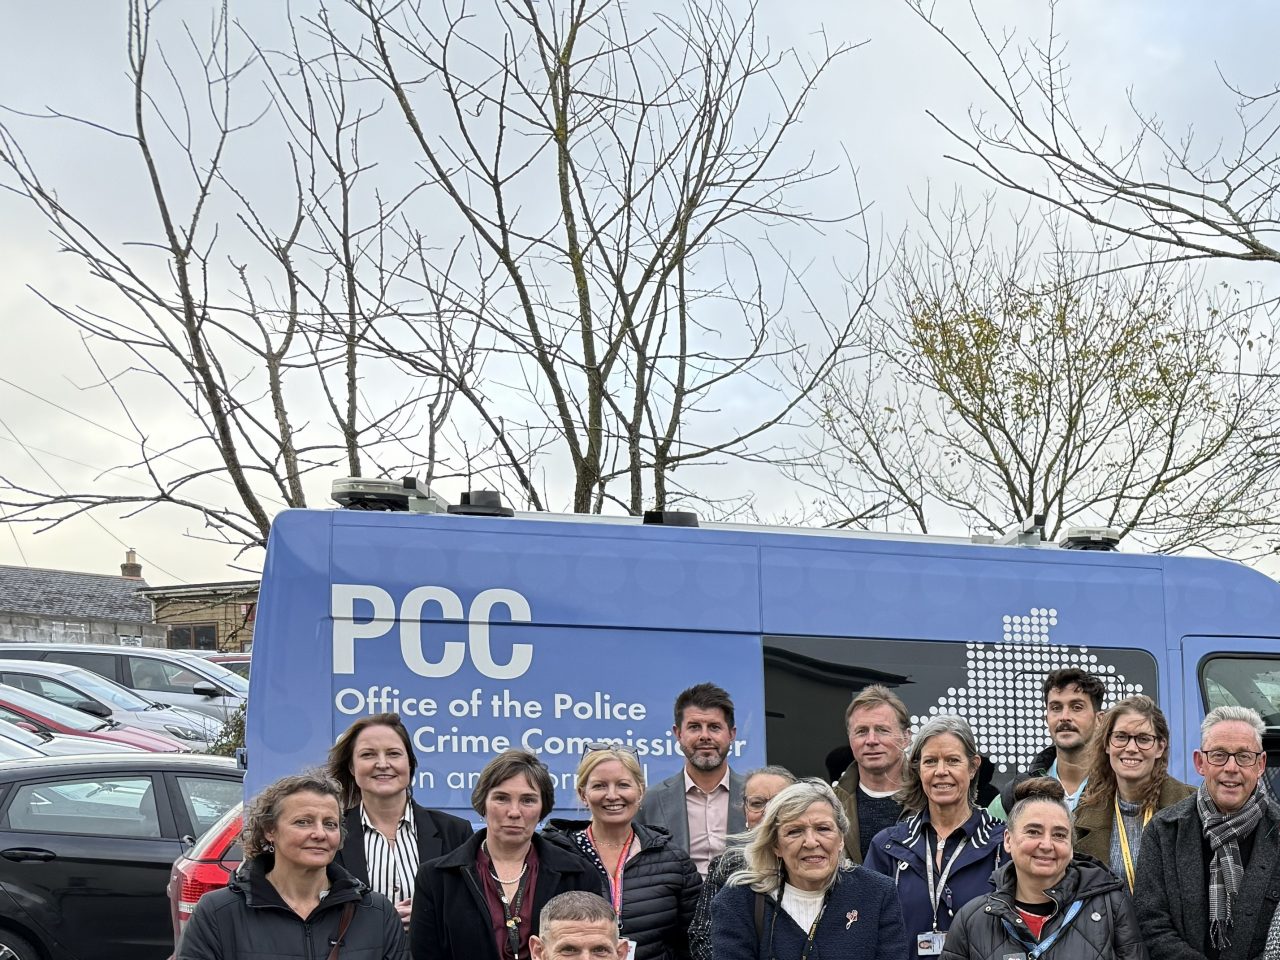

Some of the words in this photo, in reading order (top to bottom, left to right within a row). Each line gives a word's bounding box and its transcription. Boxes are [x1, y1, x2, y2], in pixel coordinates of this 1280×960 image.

[331, 583, 533, 679] PCC
[335, 686, 438, 716] Office
[448, 688, 482, 717] of
[491, 690, 543, 719] the
[554, 692, 647, 721] Police
[413, 726, 510, 753] Crime
